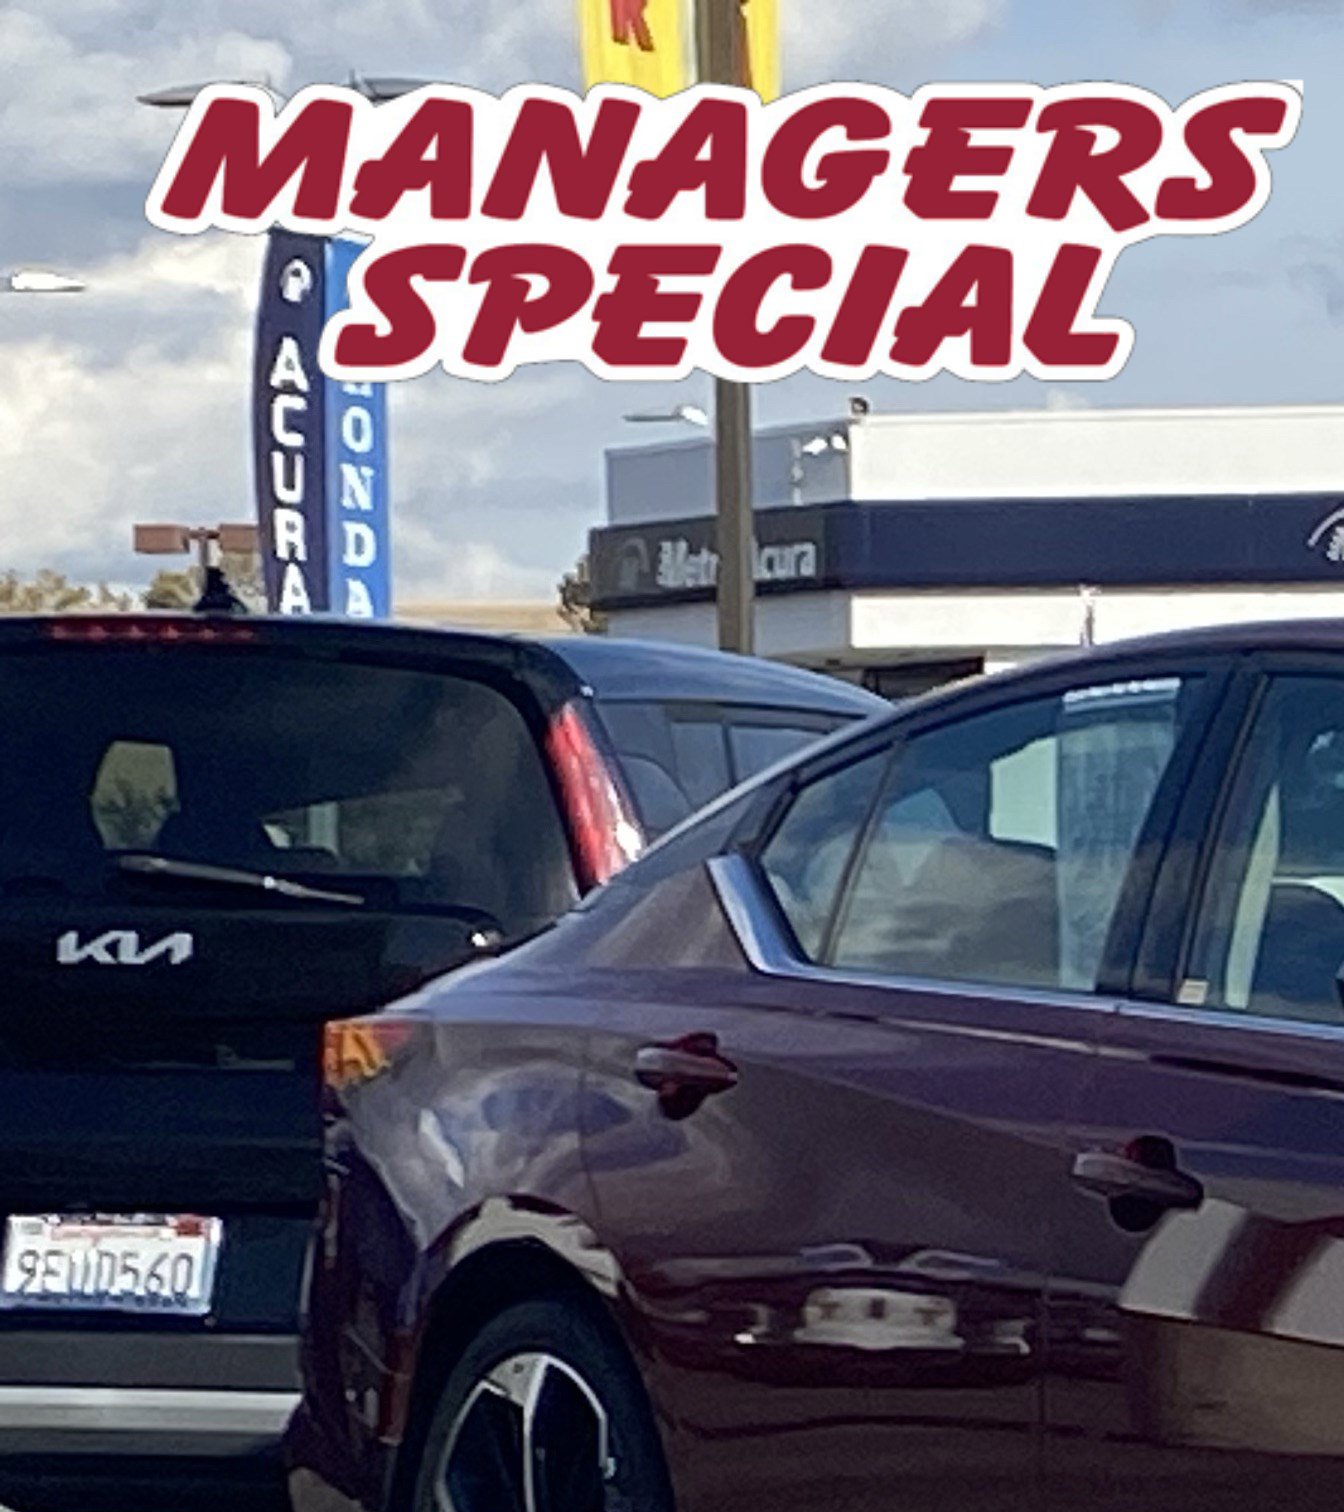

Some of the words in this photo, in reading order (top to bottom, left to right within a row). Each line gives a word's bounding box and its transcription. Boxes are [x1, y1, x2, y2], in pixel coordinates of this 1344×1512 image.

[269, 335, 311, 615] ACURA
[340, 382, 377, 618] ONDA
[56, 930, 194, 965] KIA
